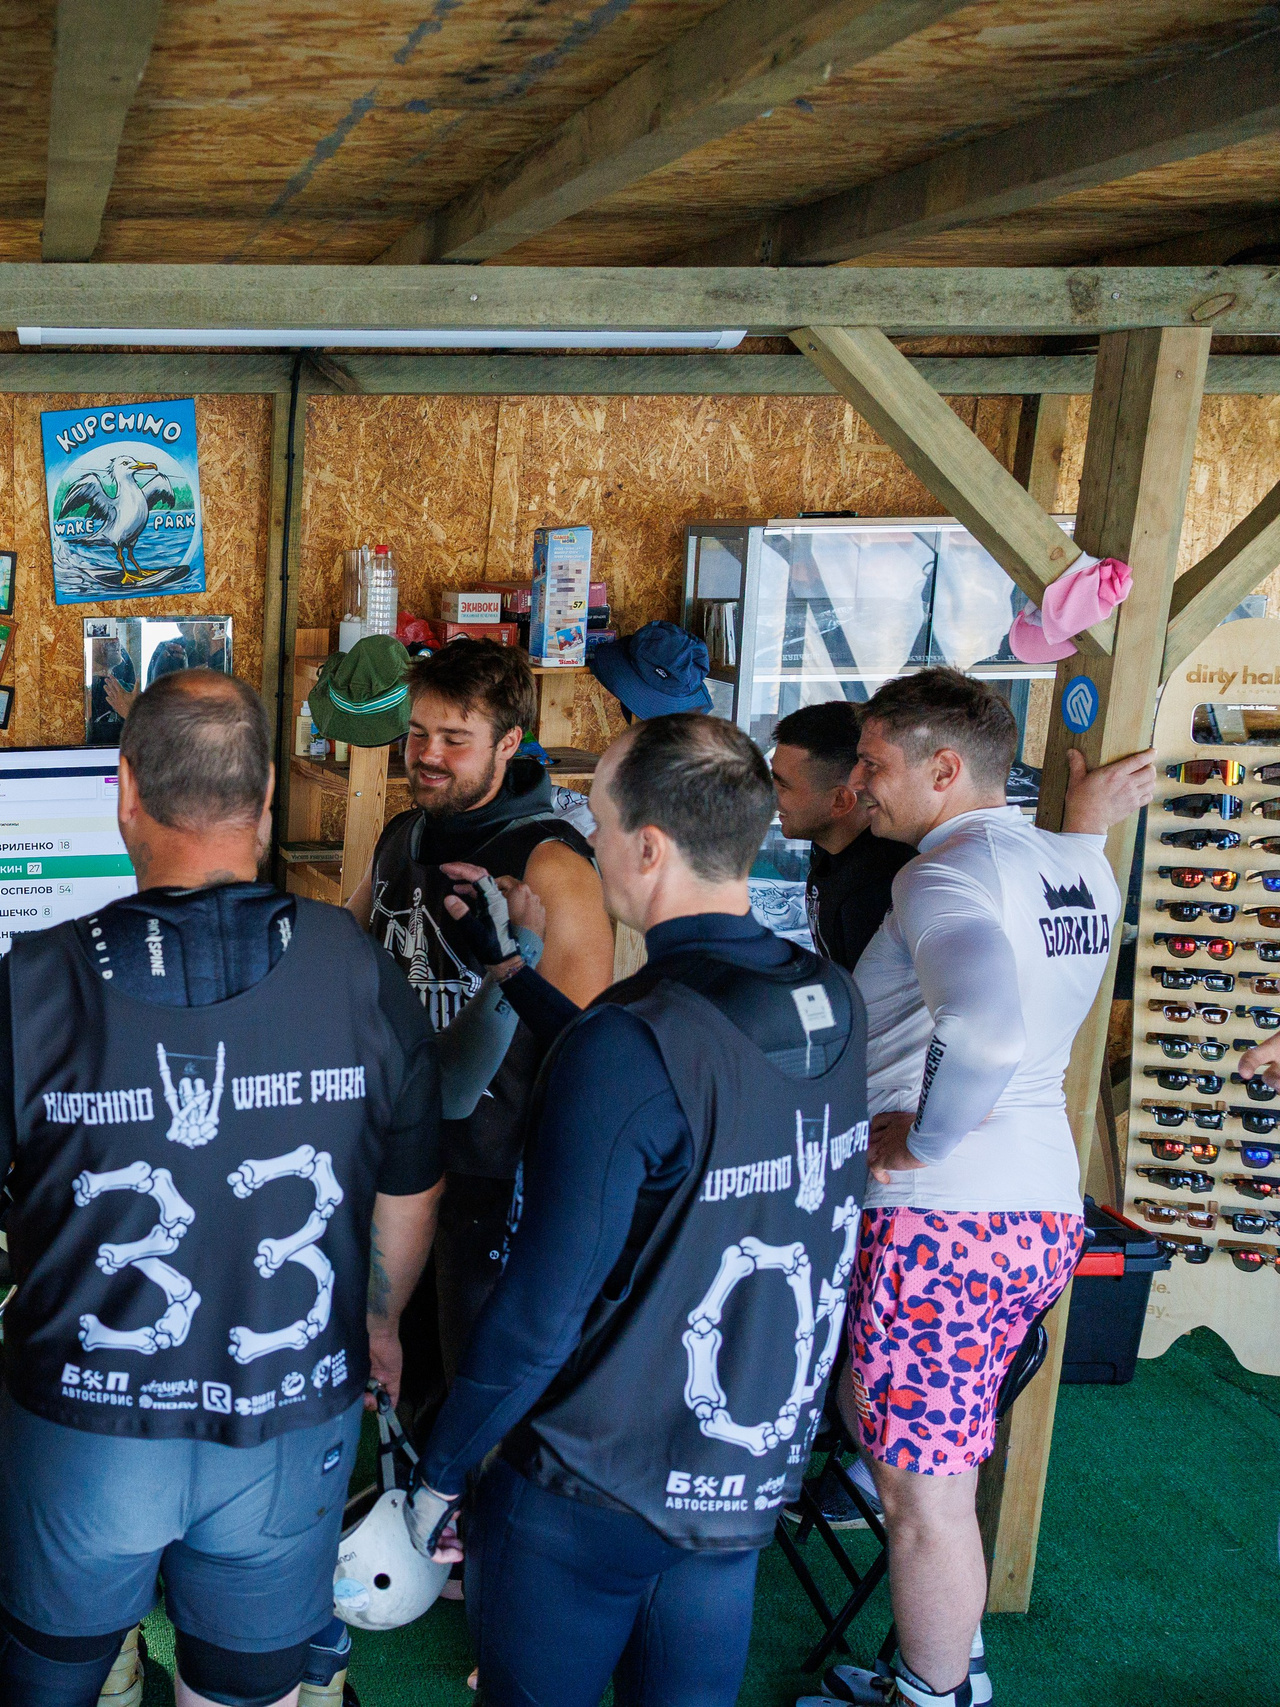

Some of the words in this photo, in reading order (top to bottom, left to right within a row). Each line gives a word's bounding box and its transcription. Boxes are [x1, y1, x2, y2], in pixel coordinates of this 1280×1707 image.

[56, 412, 183, 454] KUPCHINO
[54, 519, 95, 537] WAKE
[153, 514, 196, 531] PARK
[460, 601, 499, 613] ЭКИВОКИ
[572, 601, 583, 609] 57
[1186, 664, 1239, 695] dirty
[59, 840, 70, 850] 18
[28, 863, 41, 874] 27
[59, 885, 71, 894] 54
[43, 906, 51, 916] 8
[1038, 914, 1110, 958] GORILLA
[42, 1087, 155, 1125] KUPCHINO
[231, 1071, 303, 1110] WAKE
[310, 1066, 366, 1104] PARK
[699, 1154, 793, 1203] UPCHINO
[72, 1144, 344, 1365] 33
[61, 1386, 133, 1407] АВТОСЕРВИС
[665, 1495, 749, 1512] АВТОСЕРВИС
